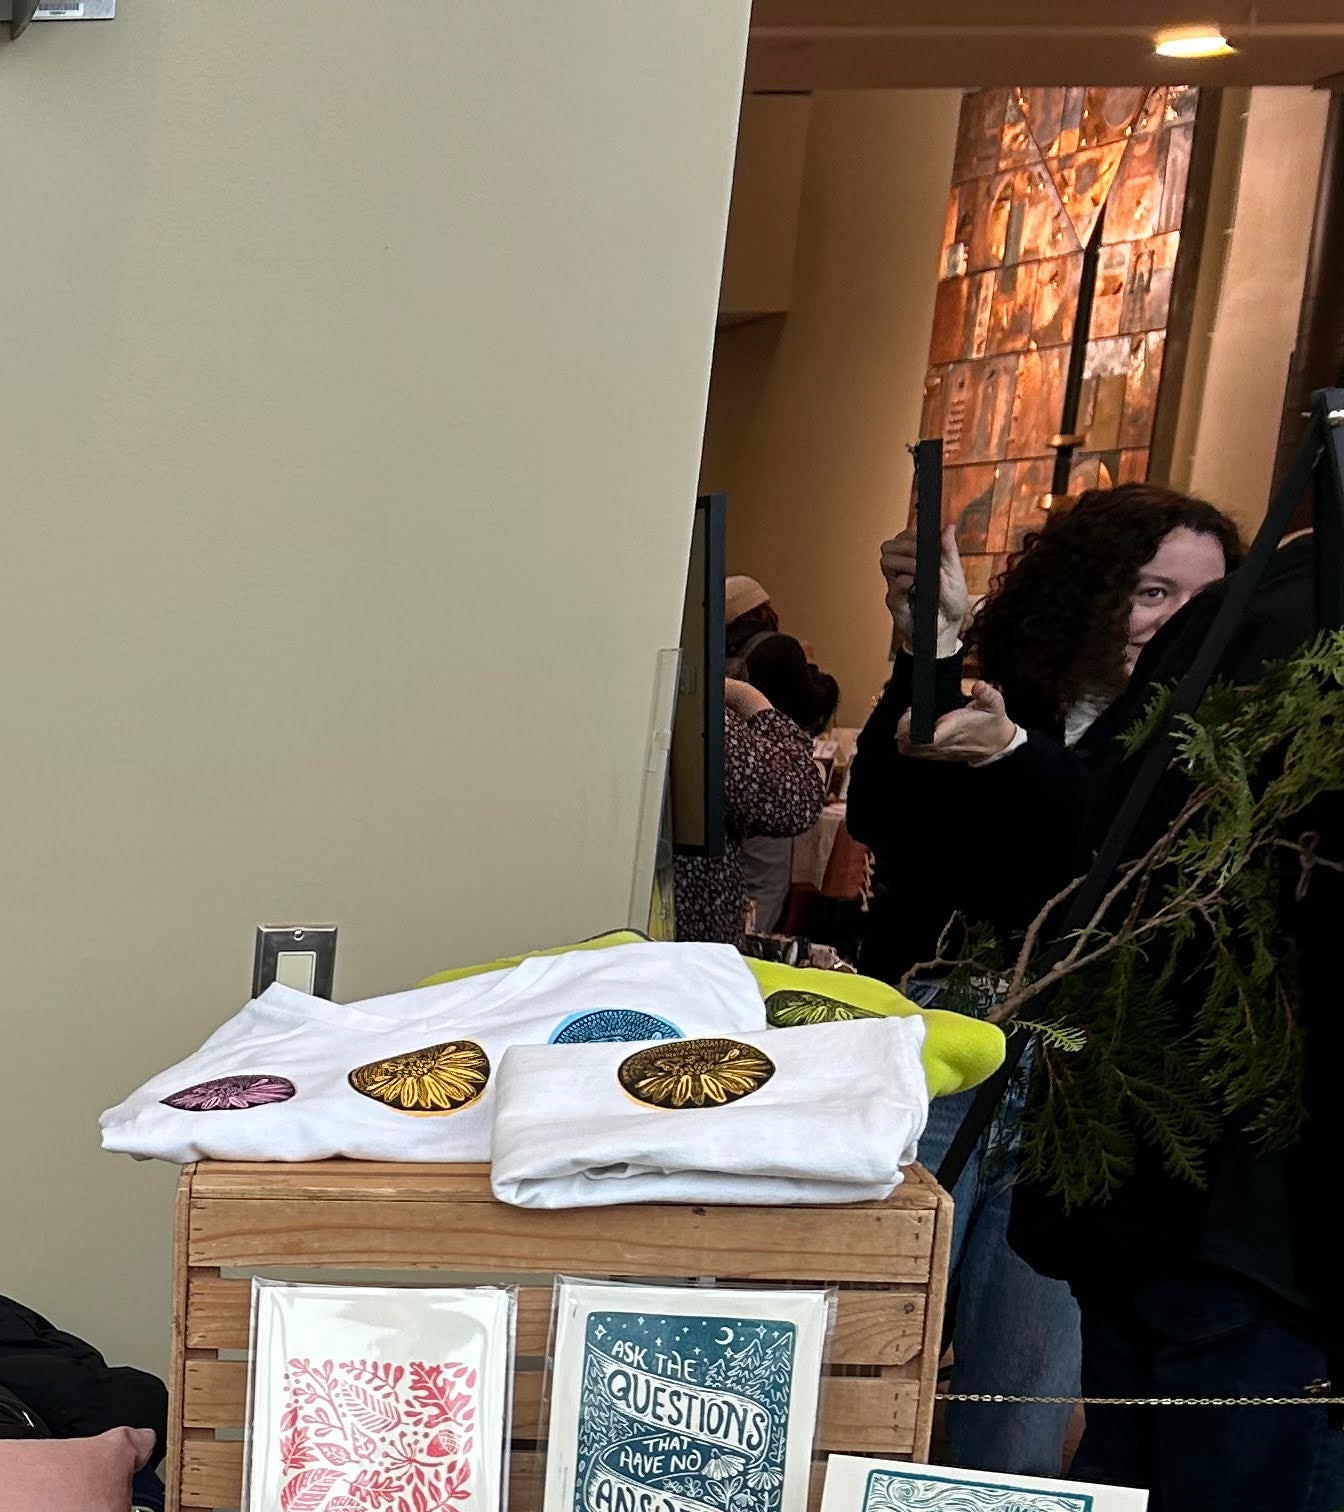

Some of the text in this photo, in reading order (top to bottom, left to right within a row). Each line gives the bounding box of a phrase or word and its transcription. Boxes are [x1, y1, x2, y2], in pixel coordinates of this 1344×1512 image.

[612, 1340, 698, 1382] ASK THE
[607, 1369, 766, 1451] QUESTIONS
[619, 1446, 702, 1478] HAVE NO
[643, 1436, 691, 1453] THAT
